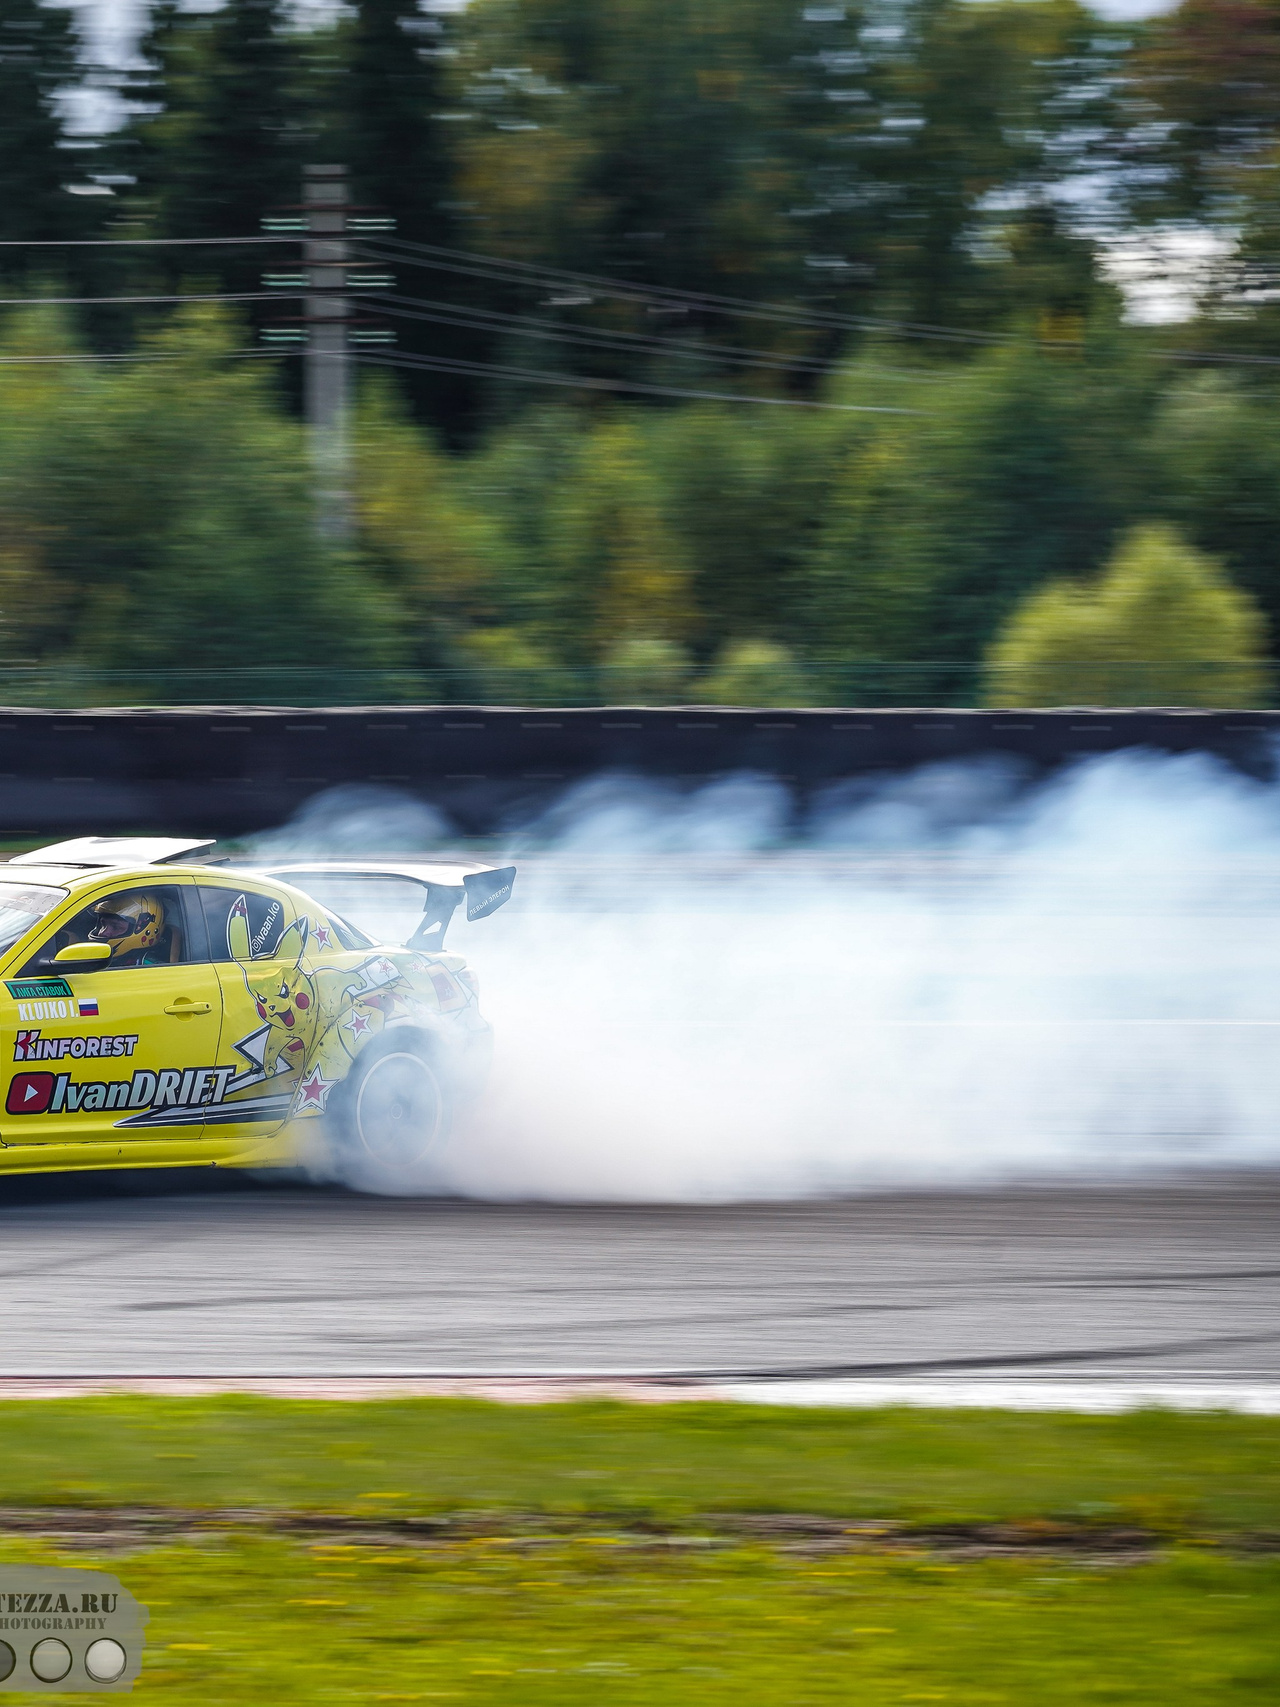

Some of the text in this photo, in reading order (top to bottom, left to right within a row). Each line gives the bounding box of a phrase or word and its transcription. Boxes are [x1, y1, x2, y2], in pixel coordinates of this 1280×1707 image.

[488, 885, 510, 902] ЭЛЕРОН
[16, 985, 66, 997] ЛИГА СТАВОК
[18, 1000, 79, 1021] KLUIKO I.
[14, 1031, 138, 1061] KINFOREST
[49, 1066, 235, 1112] IvanDRIFT
